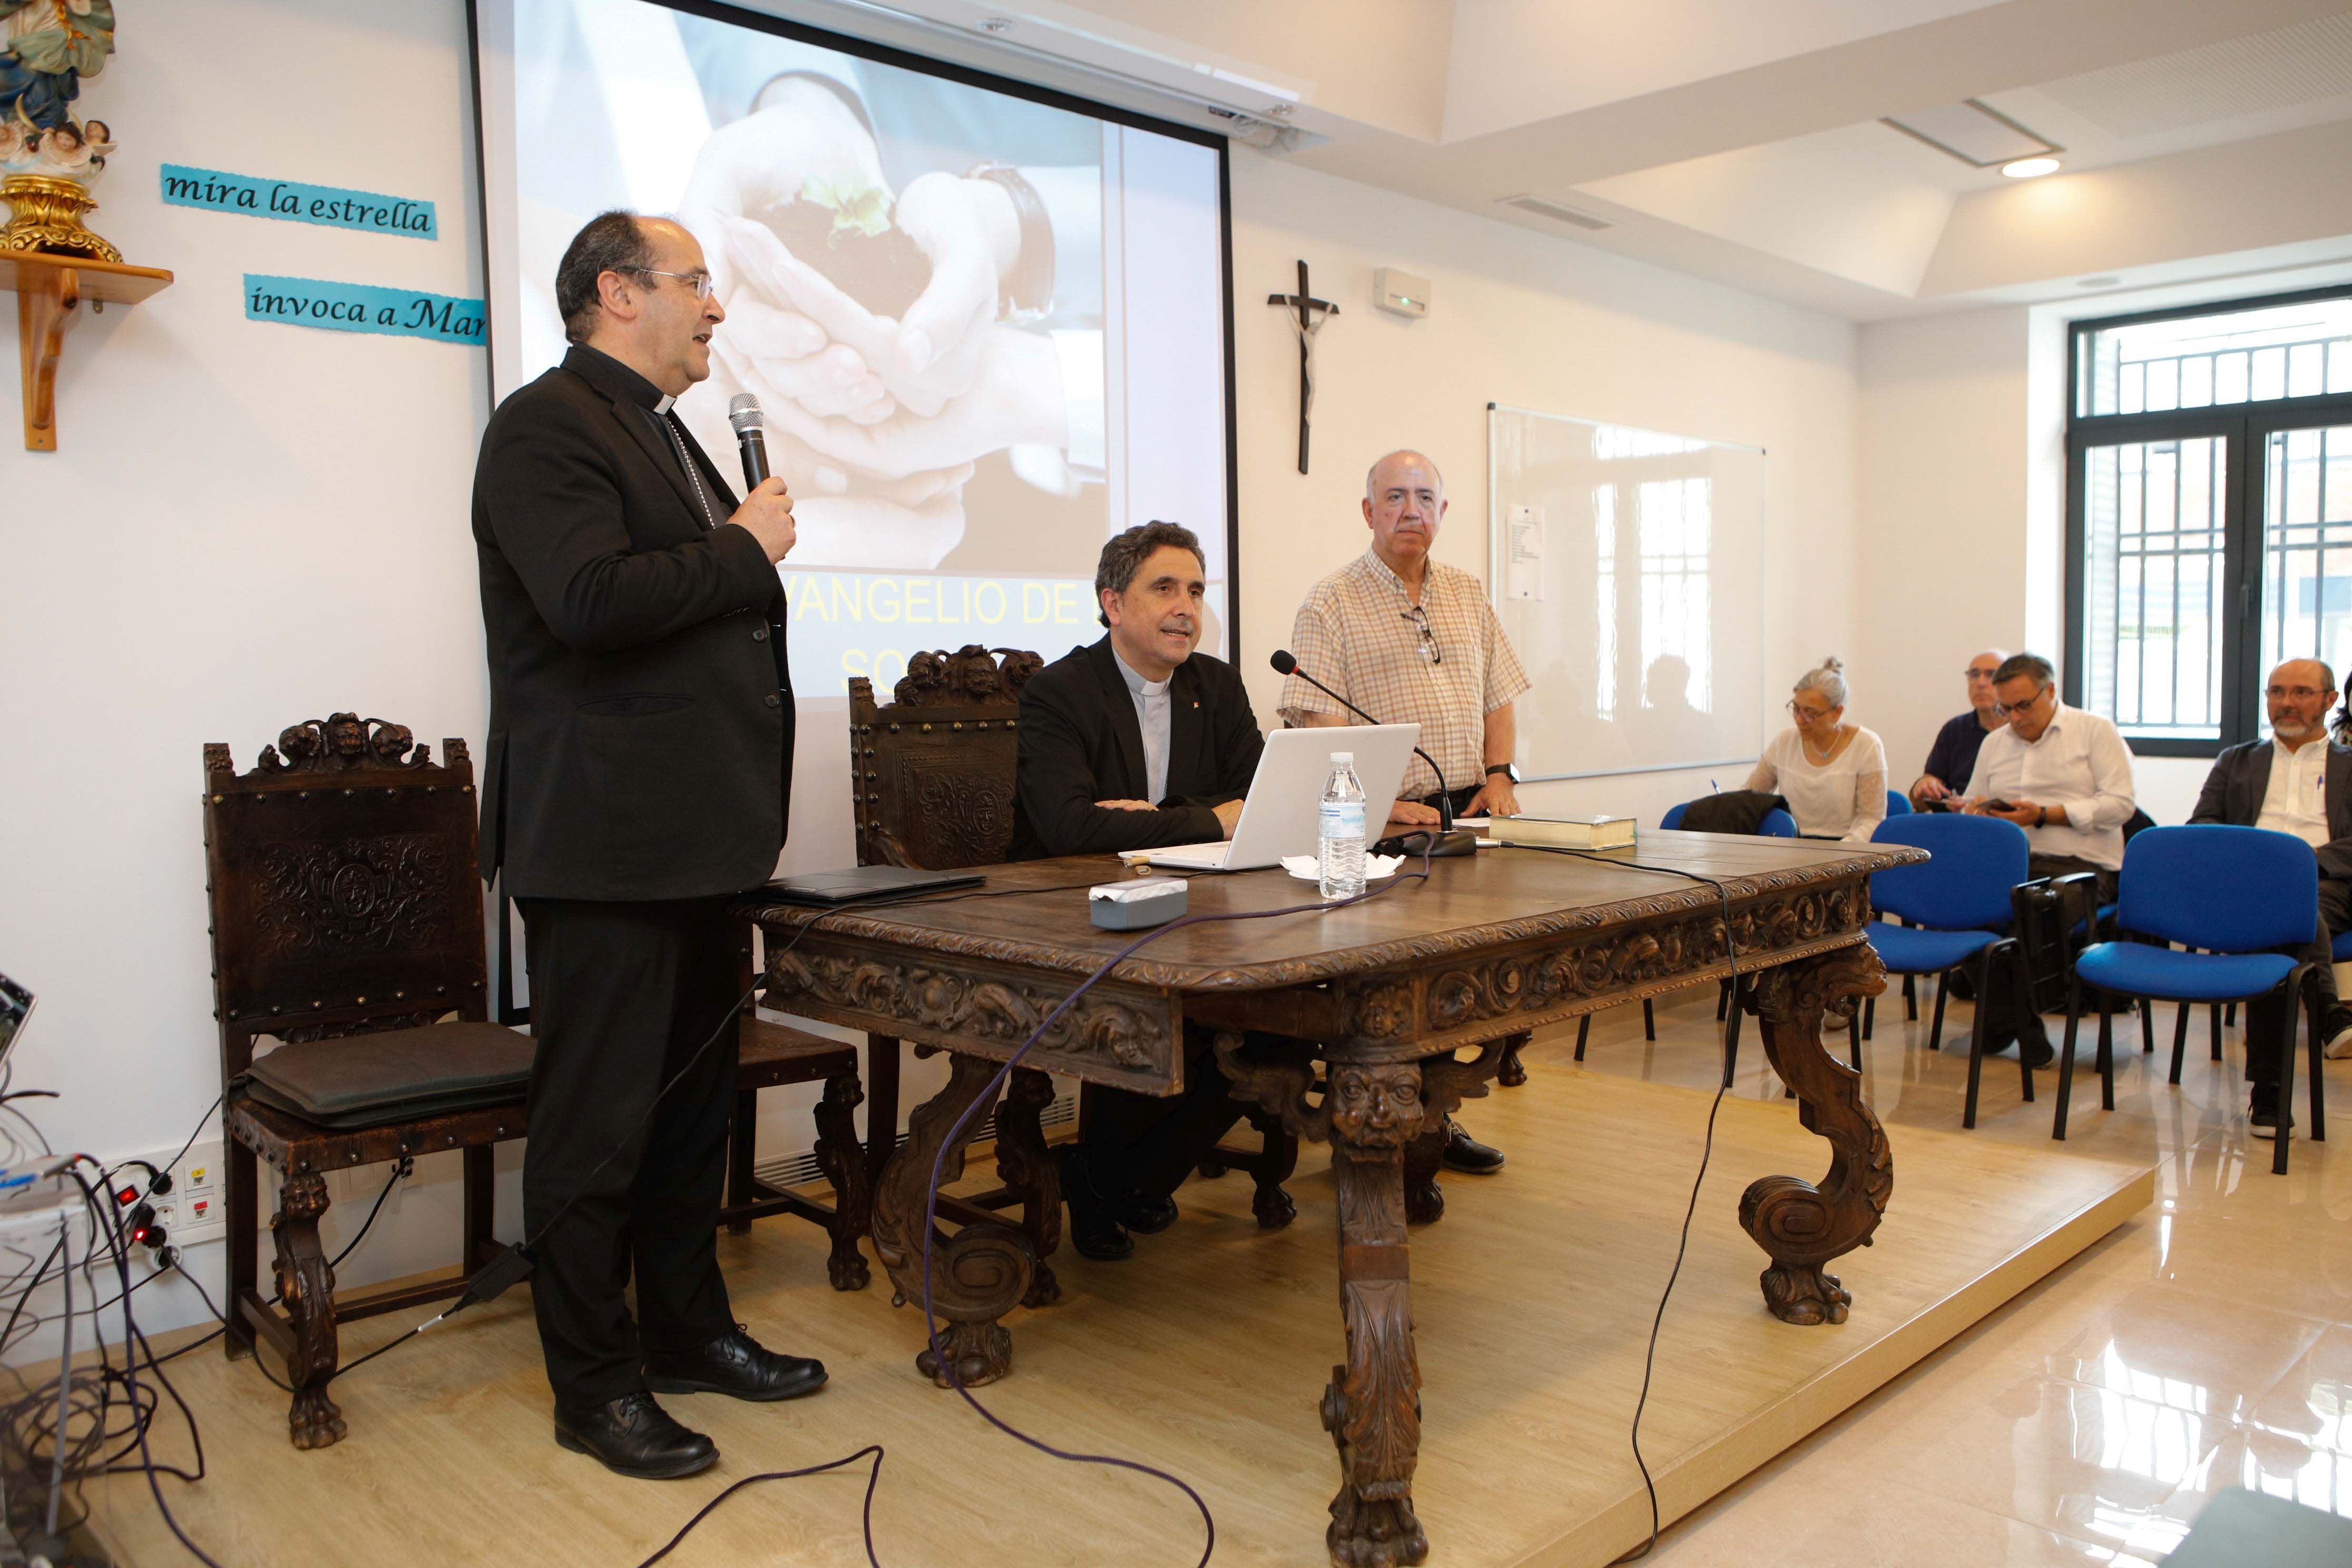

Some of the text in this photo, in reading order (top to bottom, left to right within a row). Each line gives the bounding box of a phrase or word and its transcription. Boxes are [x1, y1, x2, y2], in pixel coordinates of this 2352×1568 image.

[164, 176, 432, 232] mira la estrella
[251, 287, 366, 323] invoca
[377, 307, 397, 326] a
[1022, 582, 1080, 624] DE
